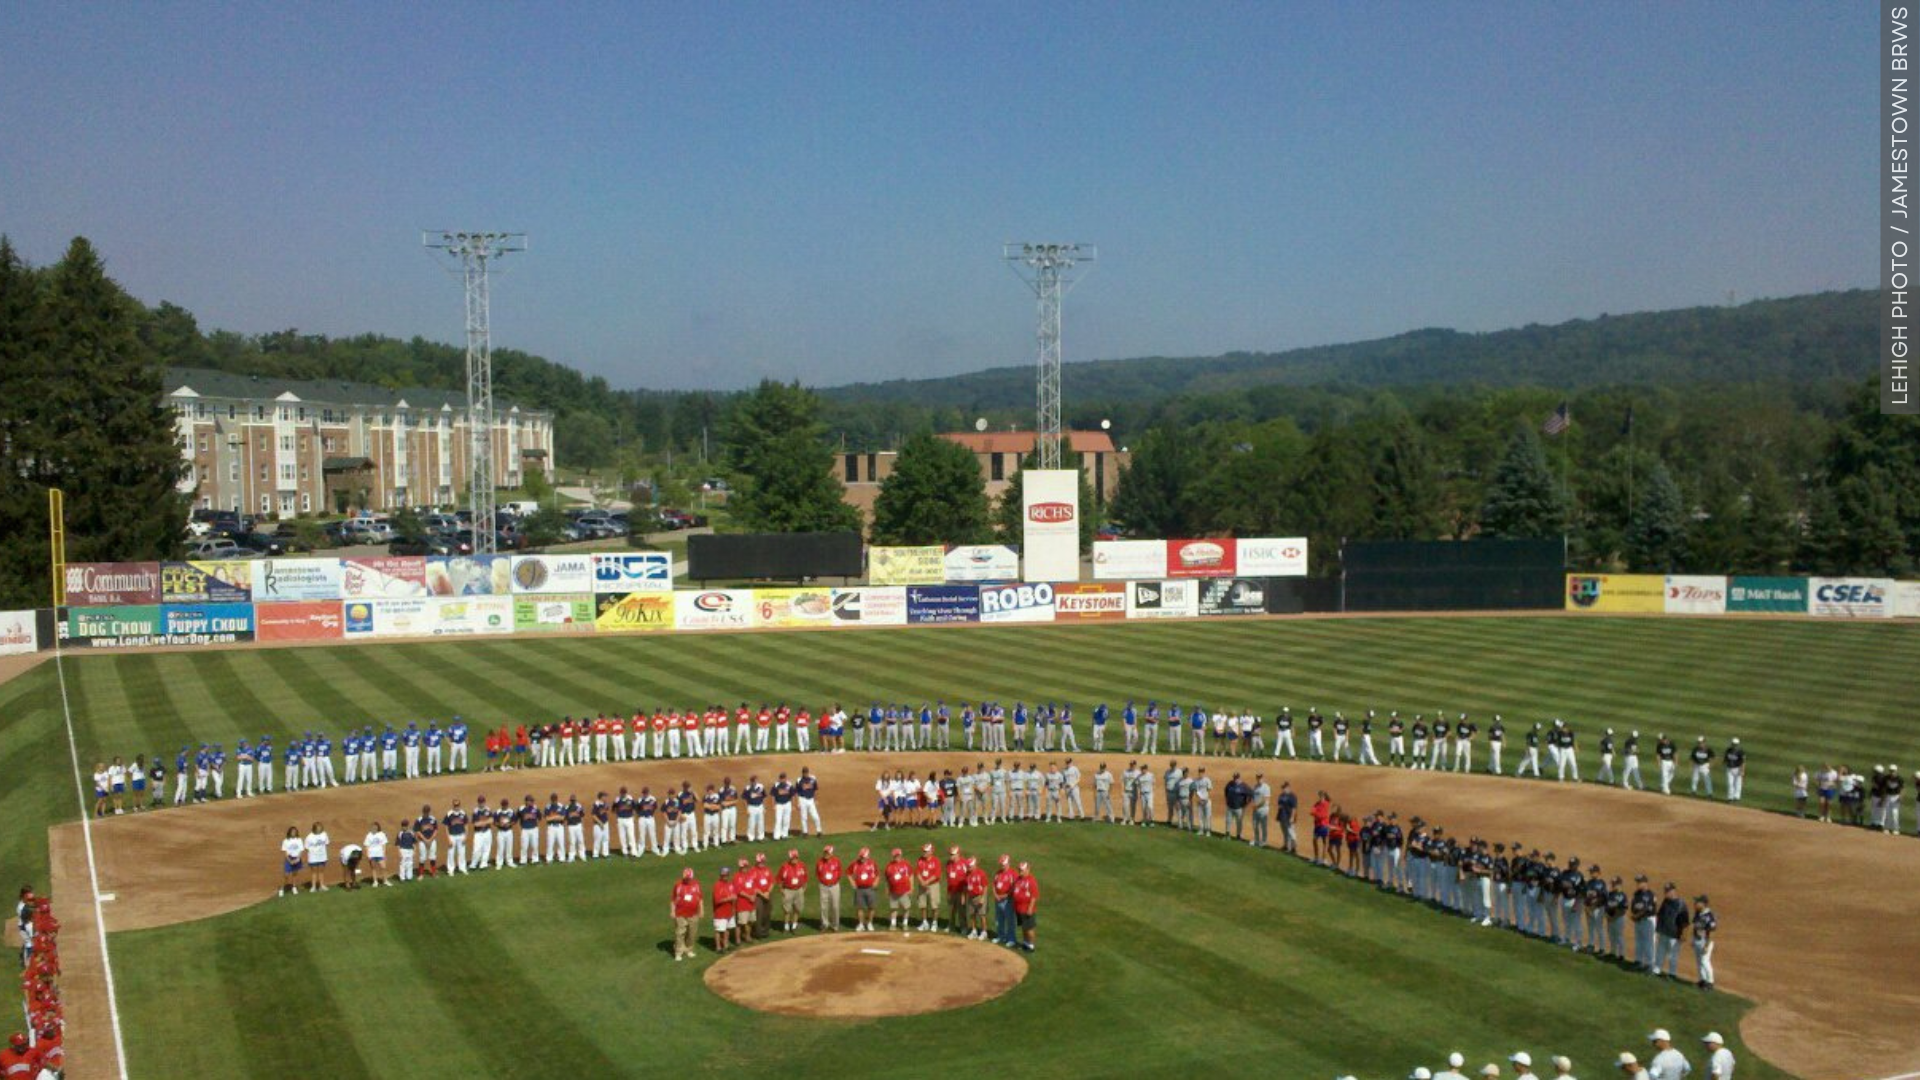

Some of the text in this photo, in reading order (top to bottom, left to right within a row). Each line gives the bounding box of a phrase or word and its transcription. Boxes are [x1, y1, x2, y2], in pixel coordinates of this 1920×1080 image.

[1243, 547, 1277, 558] HSBC
[554, 562, 586, 572] JAMA
[84, 567, 157, 598] Community
[982, 584, 1053, 612] ROBO
[1774, 589, 1802, 600] Bank
[1817, 584, 1883, 602] CSEA
[1059, 597, 1123, 609] KEYSTONE
[79, 620, 152, 636] DOG CHOW
[168, 618, 248, 633] PUPPY CHOW
[91, 634, 236, 648] www.LongLiveYourDog.com
